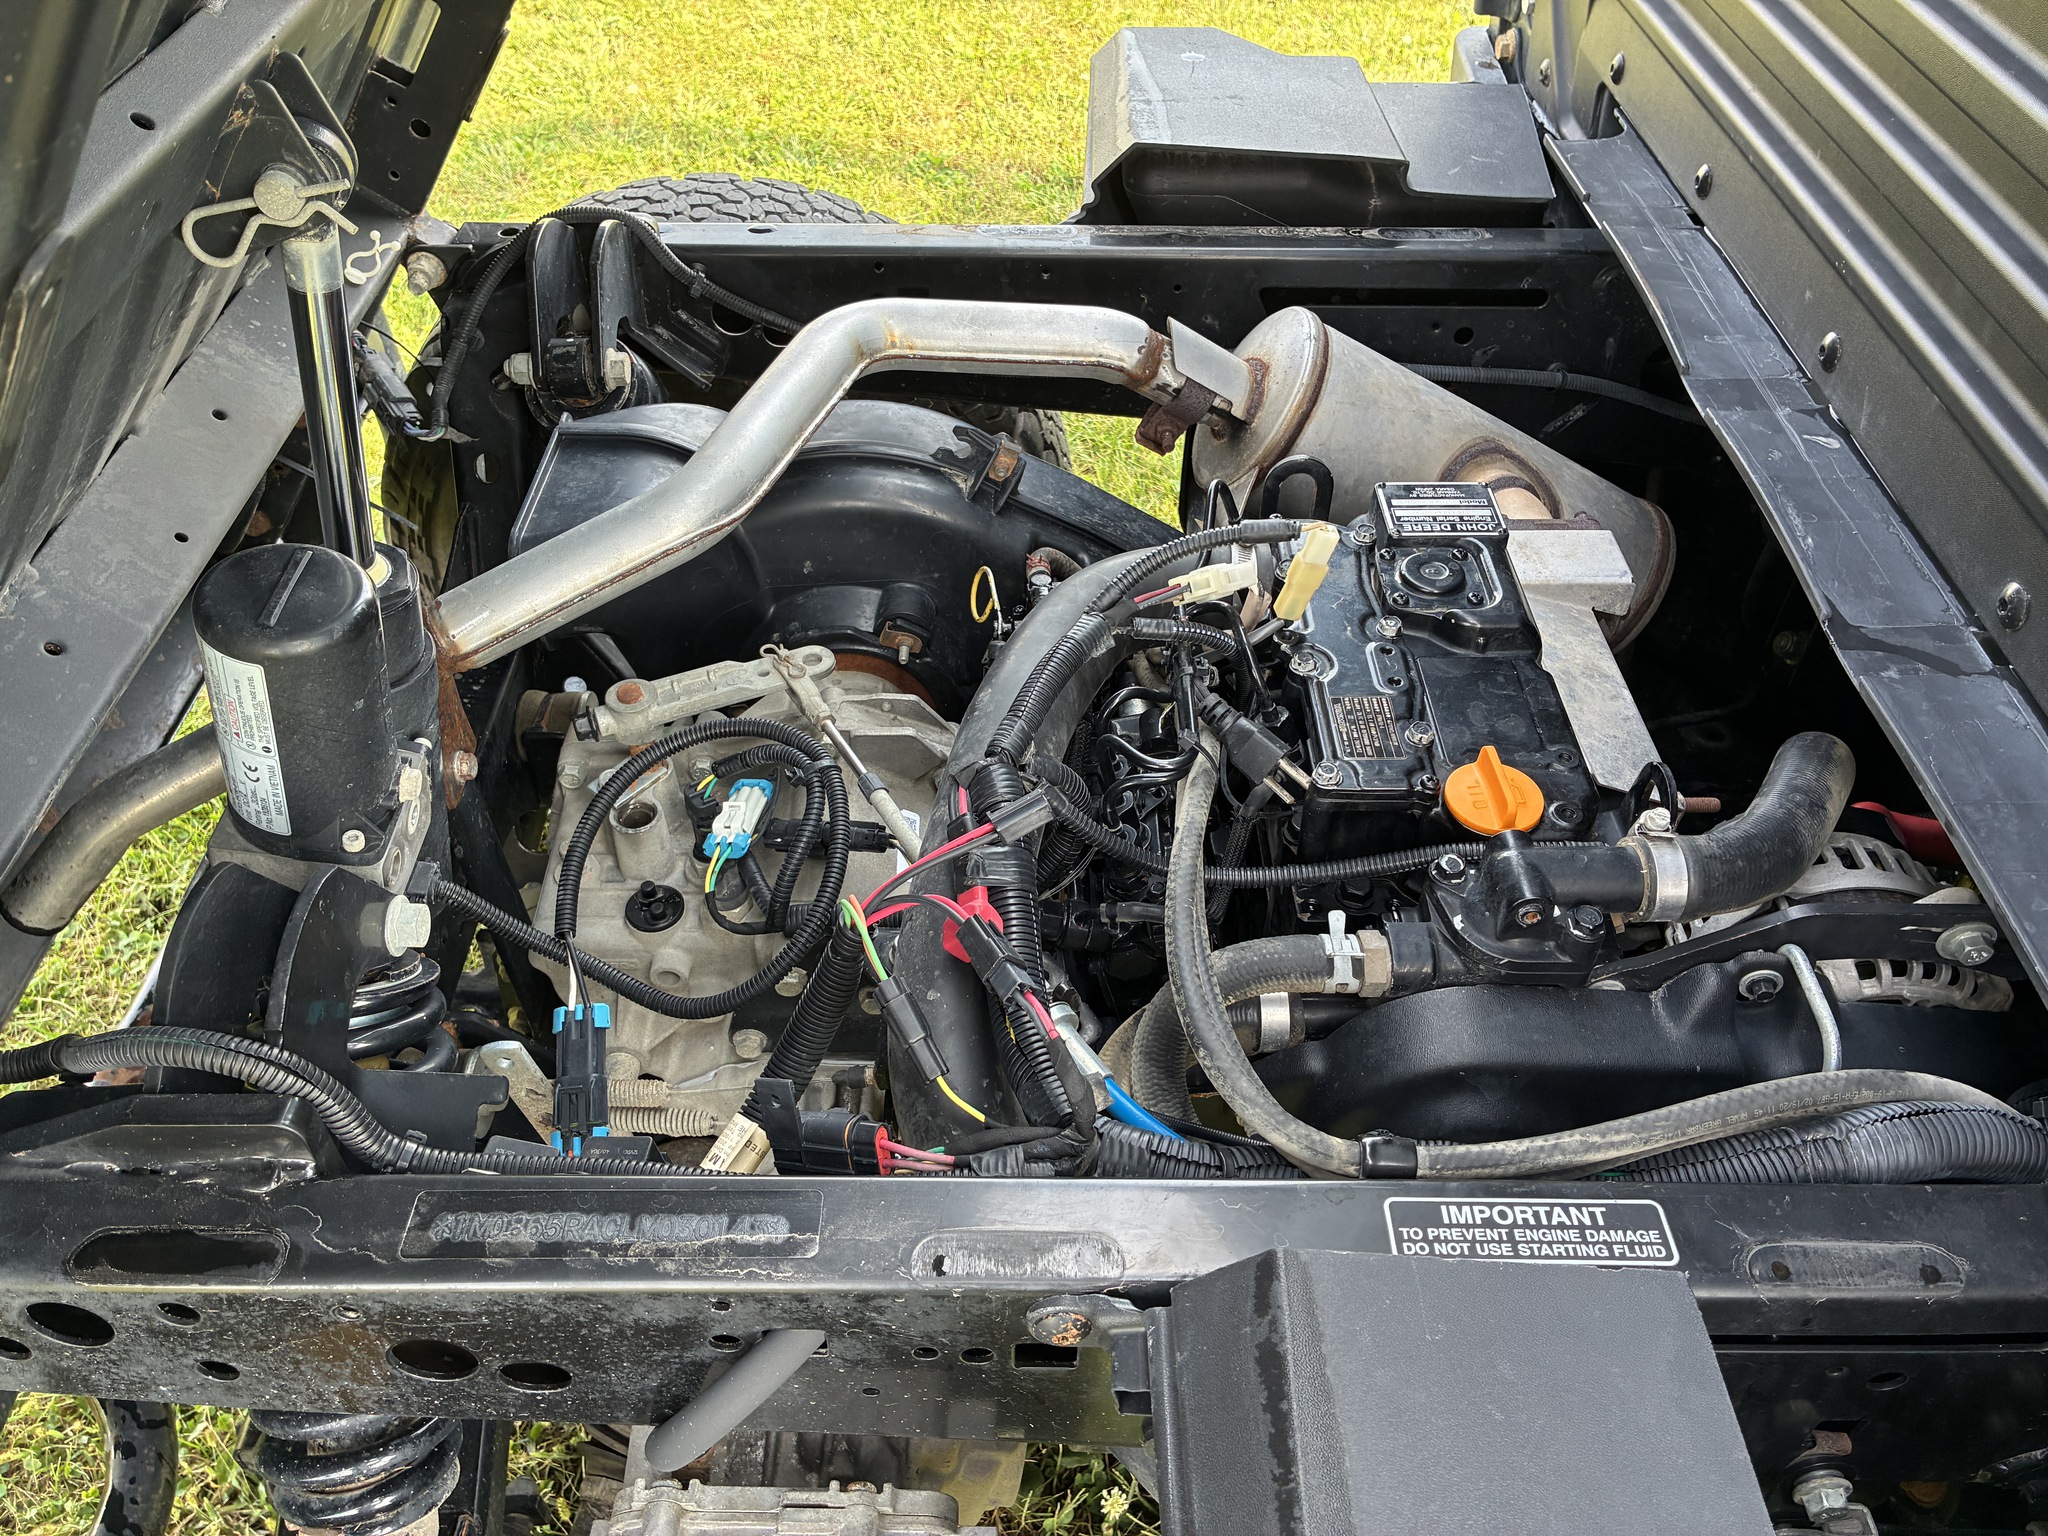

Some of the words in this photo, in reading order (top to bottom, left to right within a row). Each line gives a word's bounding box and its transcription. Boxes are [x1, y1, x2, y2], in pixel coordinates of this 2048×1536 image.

[1402, 523, 1452, 531] DEERE
[1456, 523, 1496, 531] JOHN
[250, 690, 259, 711] VOLTAGE
[228, 699, 238, 731] CAUTION
[267, 764, 280, 790] VIETNAM
[1466, 779, 1488, 809] OIL
[273, 799, 284, 816] MADE
[1779, 1097, 1813, 1112] 02/19/20
[1726, 1112, 1748, 1125] AKWEL
[1440, 1205, 1606, 1226] IMPORTANT
[1399, 1228, 1423, 1240] TO
[1428, 1228, 1509, 1241] PREVENT
[1514, 1229, 1581, 1242] ENGINE
[1586, 1230, 1662, 1243] DAMAGE
[1403, 1242, 1430, 1255] DO
[1434, 1242, 1471, 1255] NOT
[1475, 1243, 1513, 1256] USE
[1517, 1243, 1609, 1257] STARTING
[1613, 1245, 1667, 1258] FLUID
